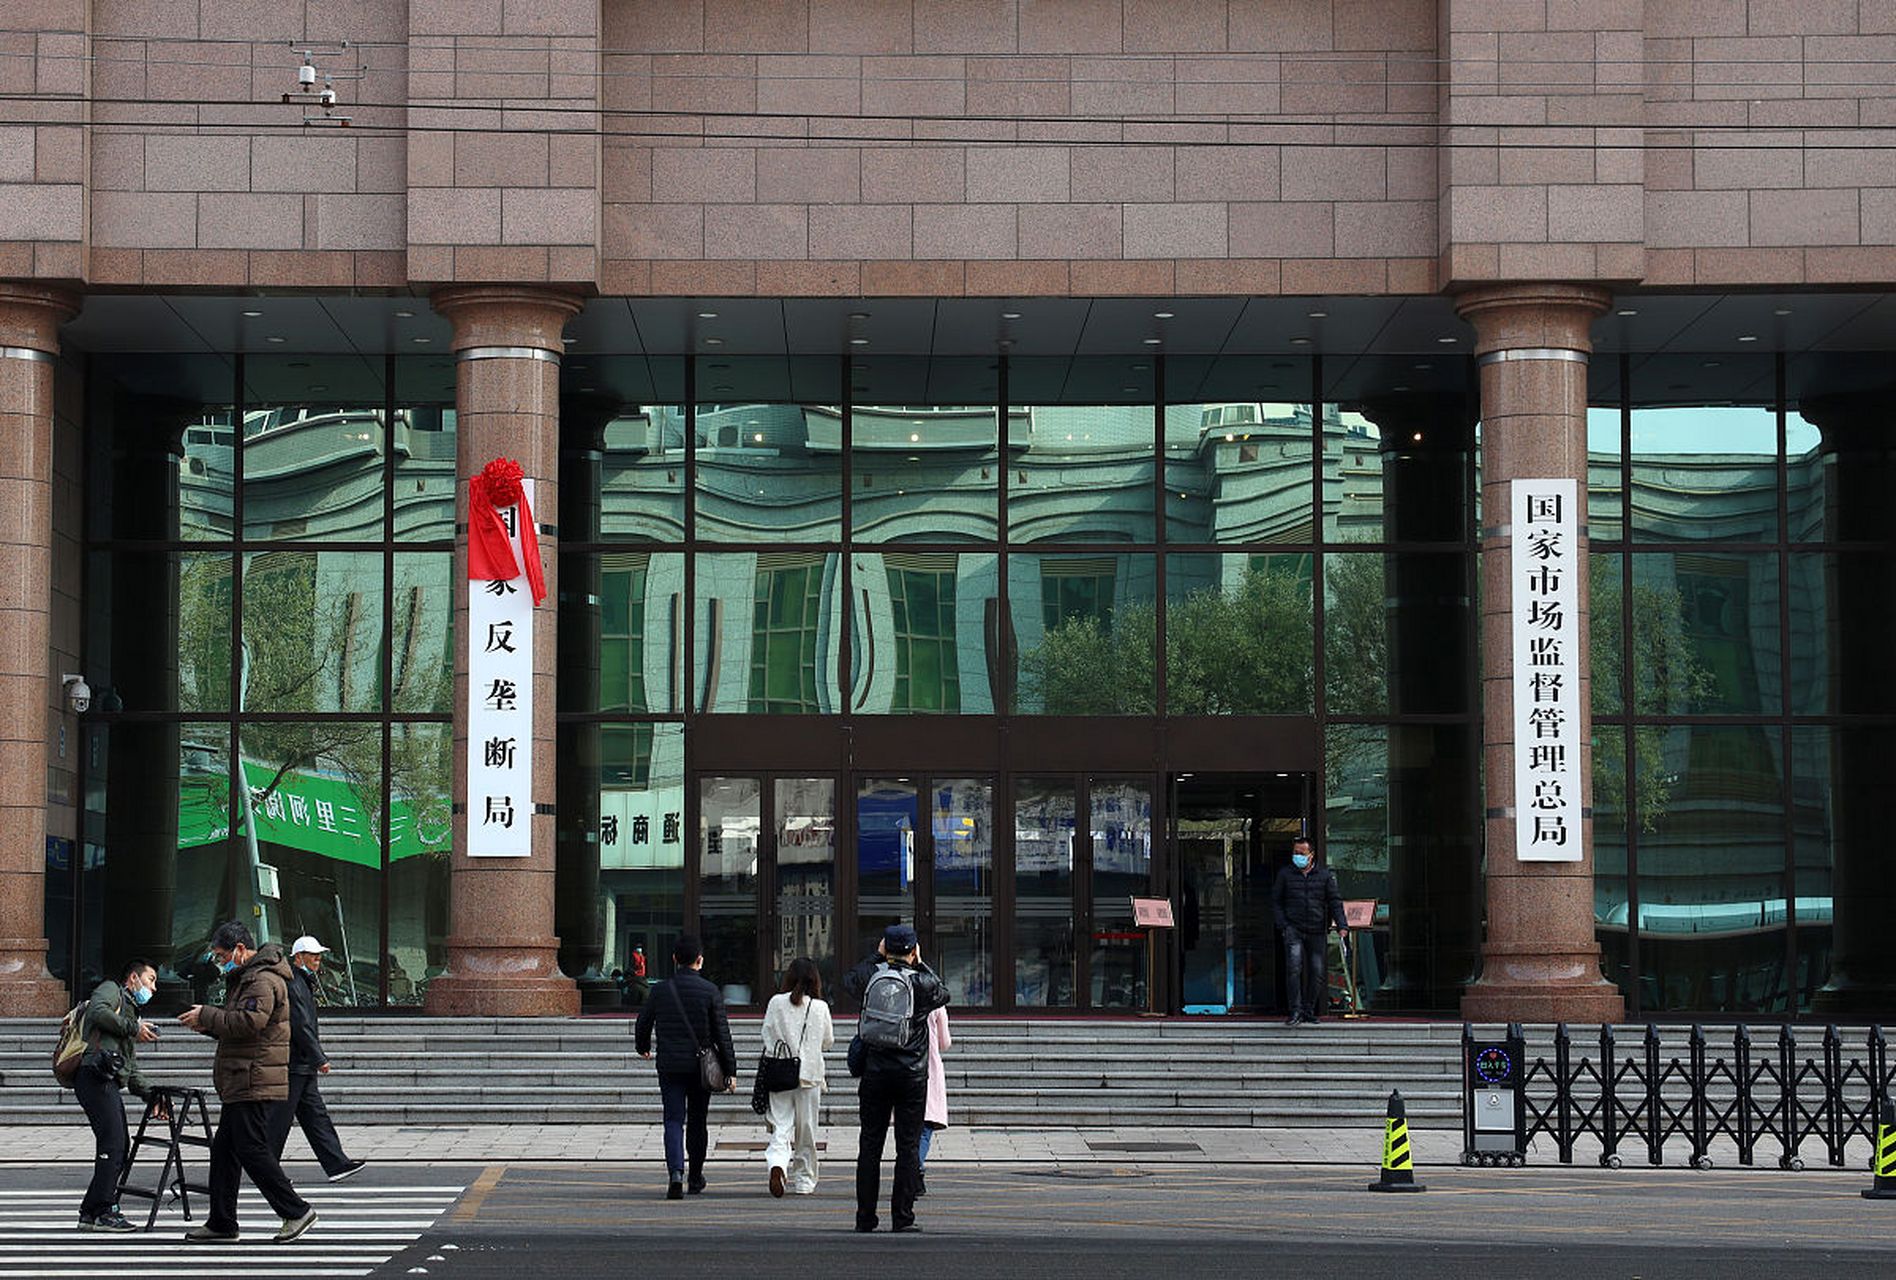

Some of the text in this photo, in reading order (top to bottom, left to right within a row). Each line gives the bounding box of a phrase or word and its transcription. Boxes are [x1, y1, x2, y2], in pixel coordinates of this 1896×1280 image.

[1526, 494, 1567, 846] 国家市场监督管理总局
